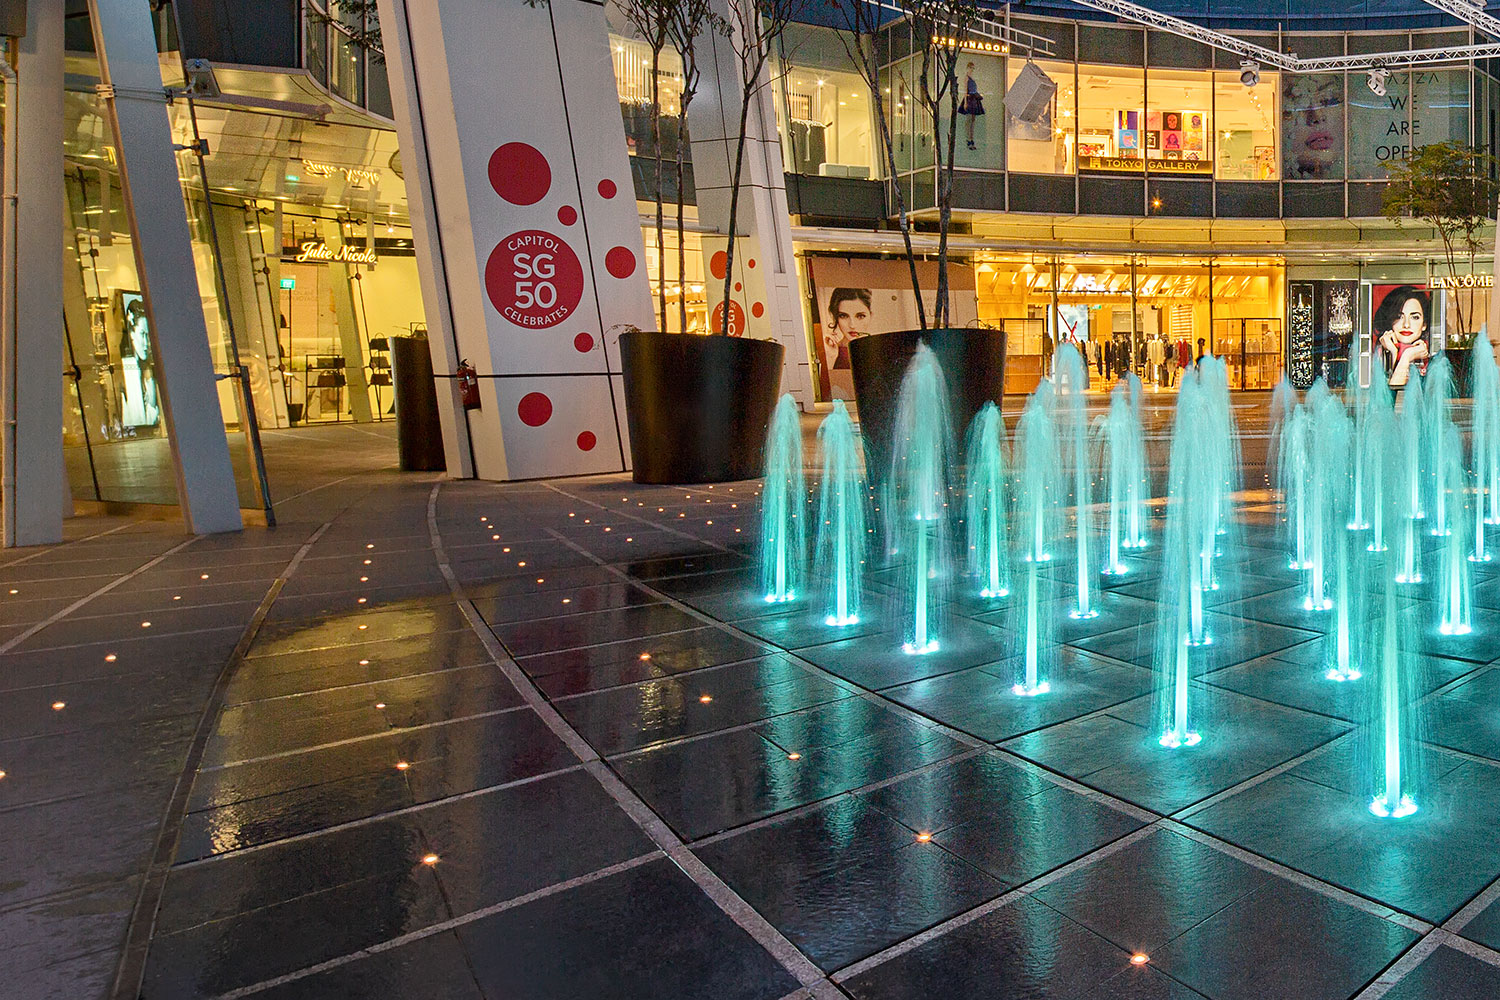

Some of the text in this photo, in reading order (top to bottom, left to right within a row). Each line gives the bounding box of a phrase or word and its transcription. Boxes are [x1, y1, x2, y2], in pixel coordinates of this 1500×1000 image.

[1386, 120, 1420, 136] ARE
[1105, 159, 1200, 170] TOKYO GALLERY
[507, 235, 560, 253] CAPITOL
[296, 242, 378, 265] Julie Nicole
[513, 253, 556, 279] SG
[1430, 272, 1494, 288] LANCÔME
[514, 281, 558, 309] 50
[504, 304, 569, 326] CELEBRATES
[721, 322, 736, 336] 0
